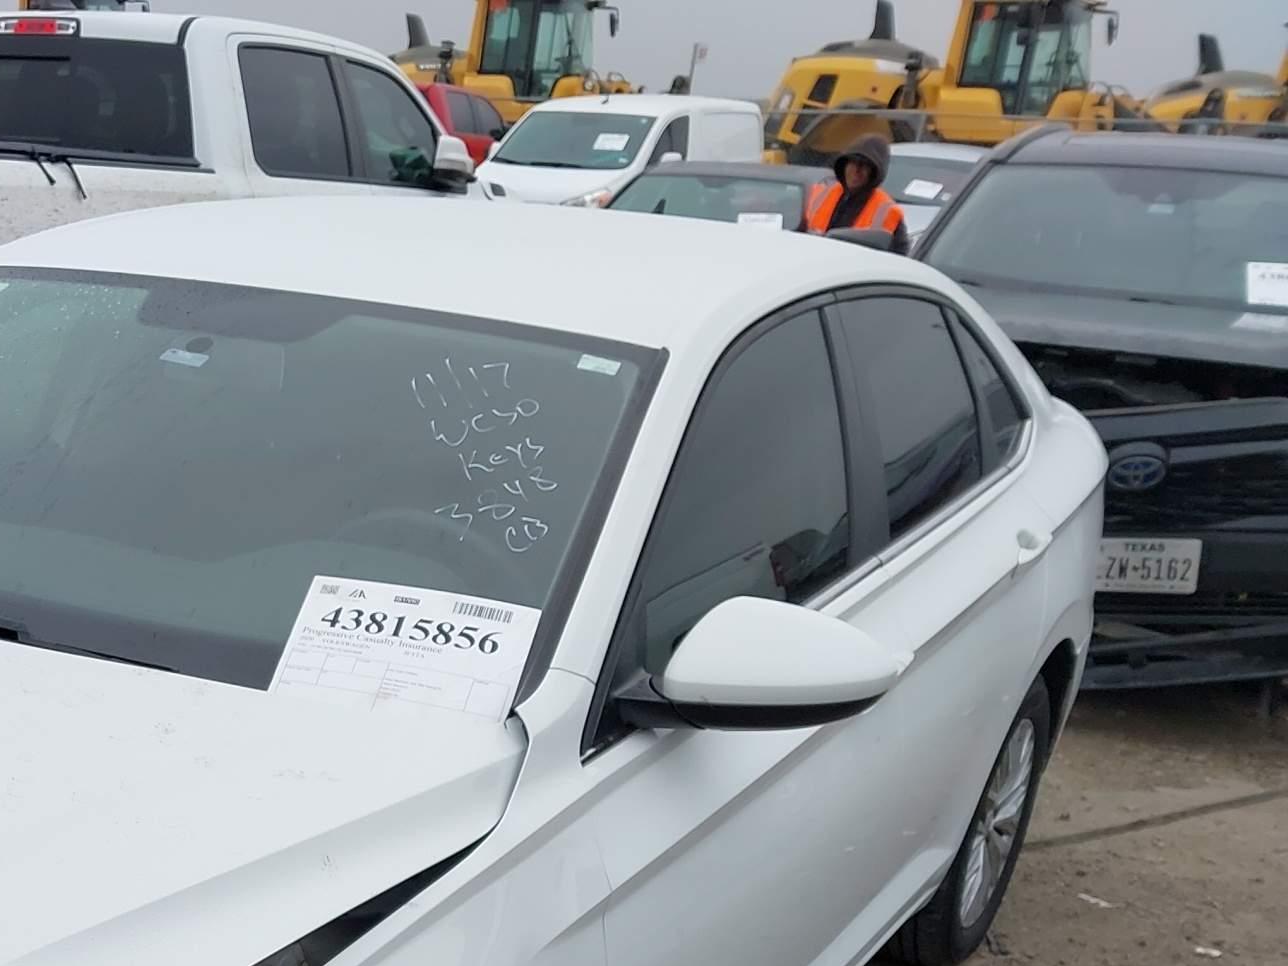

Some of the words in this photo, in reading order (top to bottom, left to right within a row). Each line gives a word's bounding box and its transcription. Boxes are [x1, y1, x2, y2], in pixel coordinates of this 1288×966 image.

[411, 357, 512, 408] 11/17
[1124, 543, 1166, 553] TEXAS
[302, 626, 356, 641] Progressive
[356, 634, 396, 648] Casualty
[398, 639, 444, 654] Insurance
[320, 605, 504, 655] 43815856
